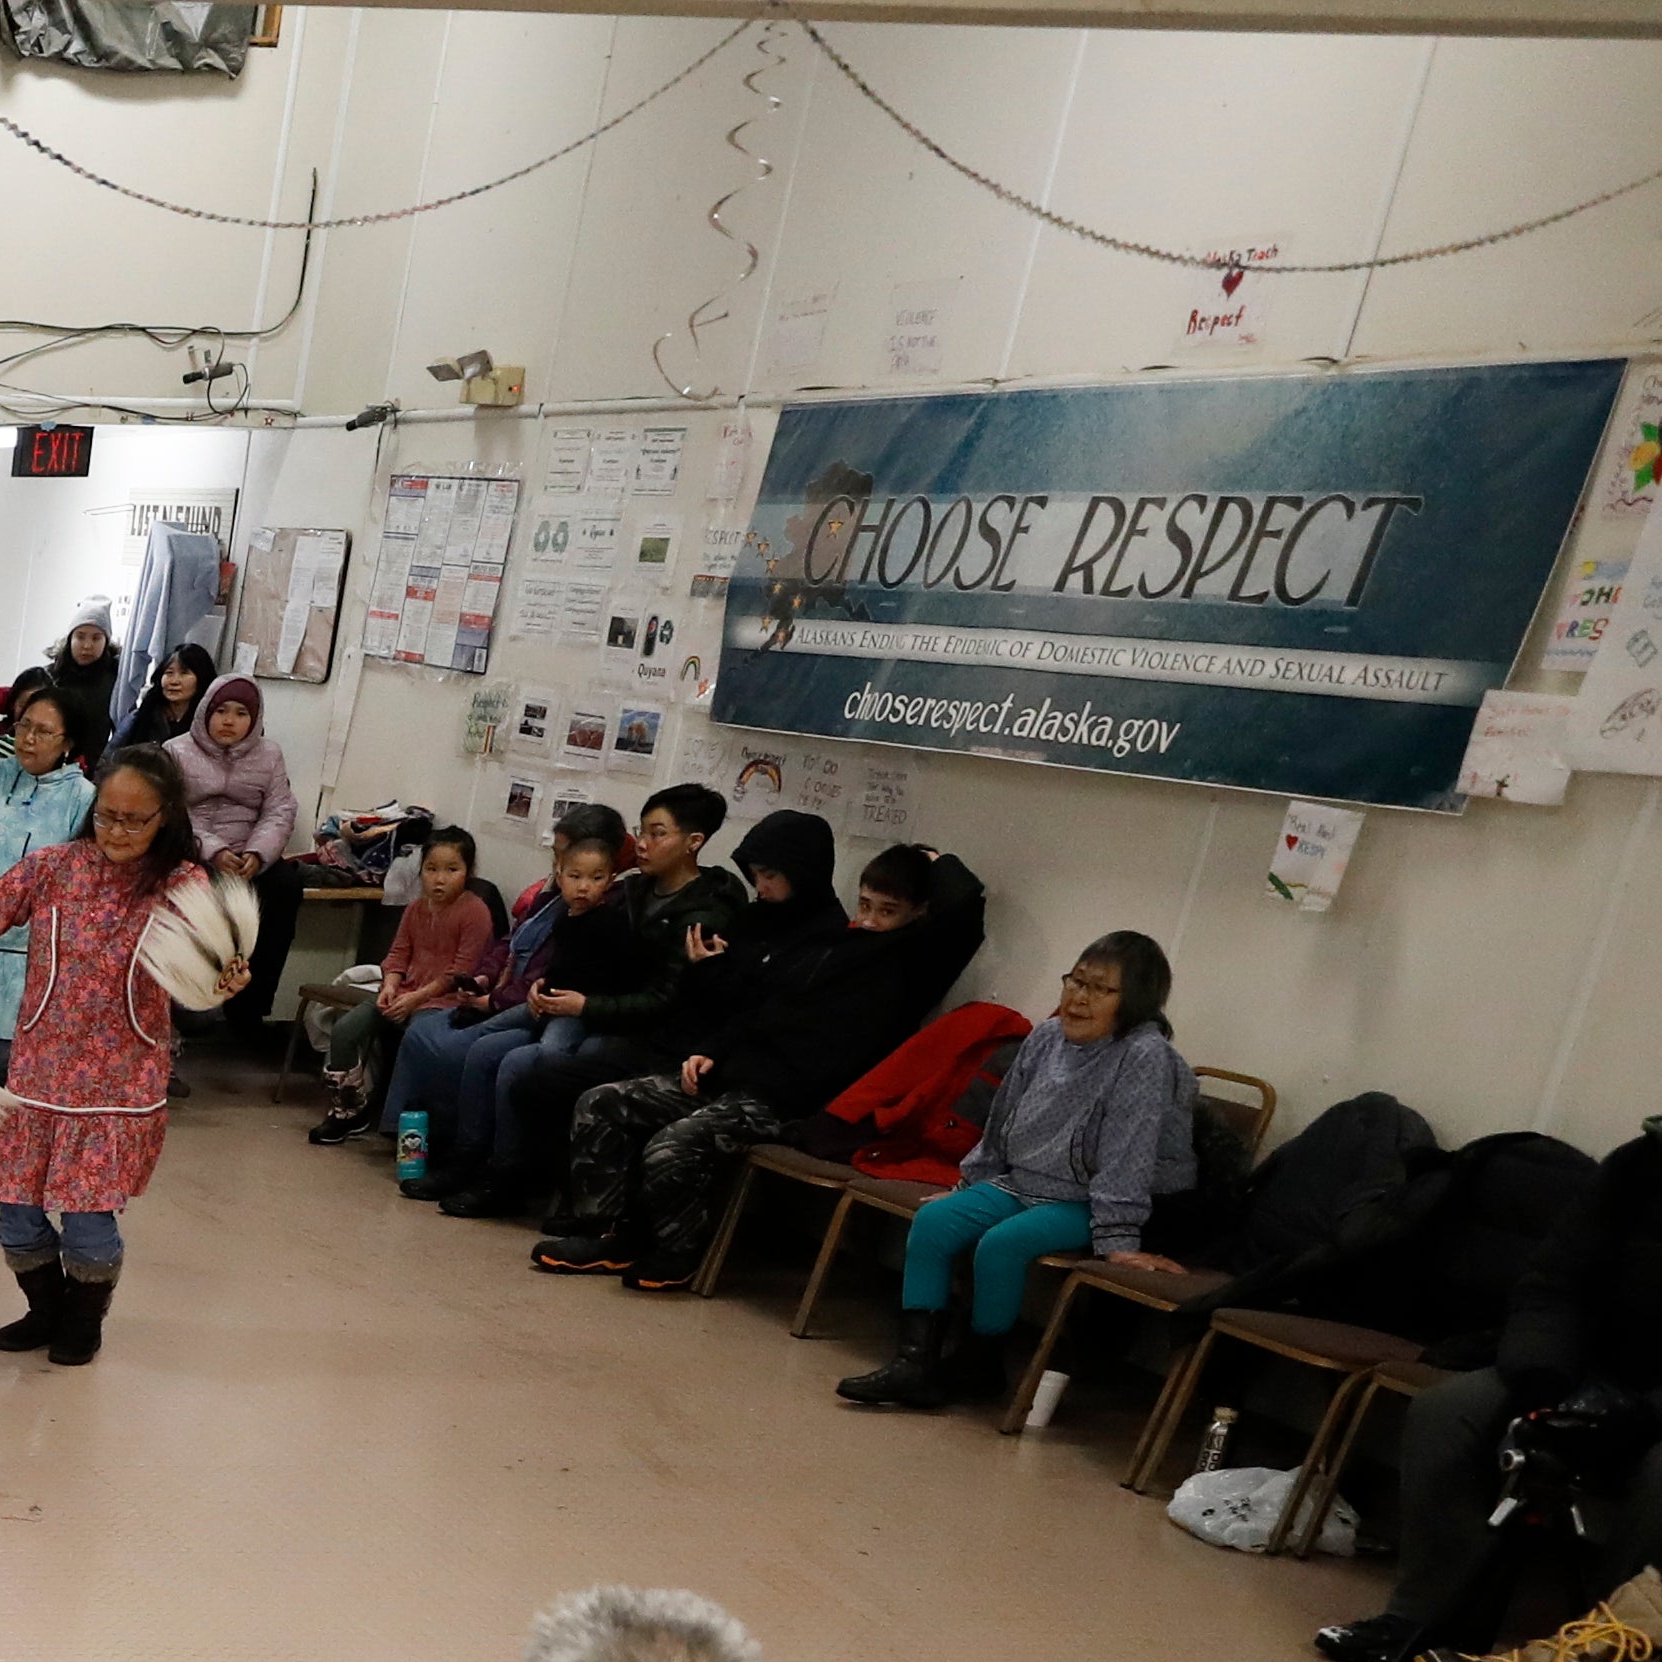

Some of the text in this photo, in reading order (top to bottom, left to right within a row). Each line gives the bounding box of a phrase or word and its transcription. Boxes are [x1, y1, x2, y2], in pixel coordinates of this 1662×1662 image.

[31, 433, 84, 473] EXIT
[803, 493, 1424, 609] CHOOSE RESPECT
[638, 663, 666, 679] Quyana
[859, 630, 908, 650] ENDING
[912, 635, 939, 653] THE
[943, 636, 1003, 657] EPIDEMIC
[1009, 641, 1033, 659] OF
[1037, 641, 1122, 667] DOMESTIC
[1128, 648, 1216, 674] VIOLENCE
[1218, 658, 1265, 678] AND
[1270, 658, 1347, 684] SEXUAL
[1353, 663, 1448, 692] ASSAULT
[844, 681, 1180, 758] chooserespect.alaska.gov
